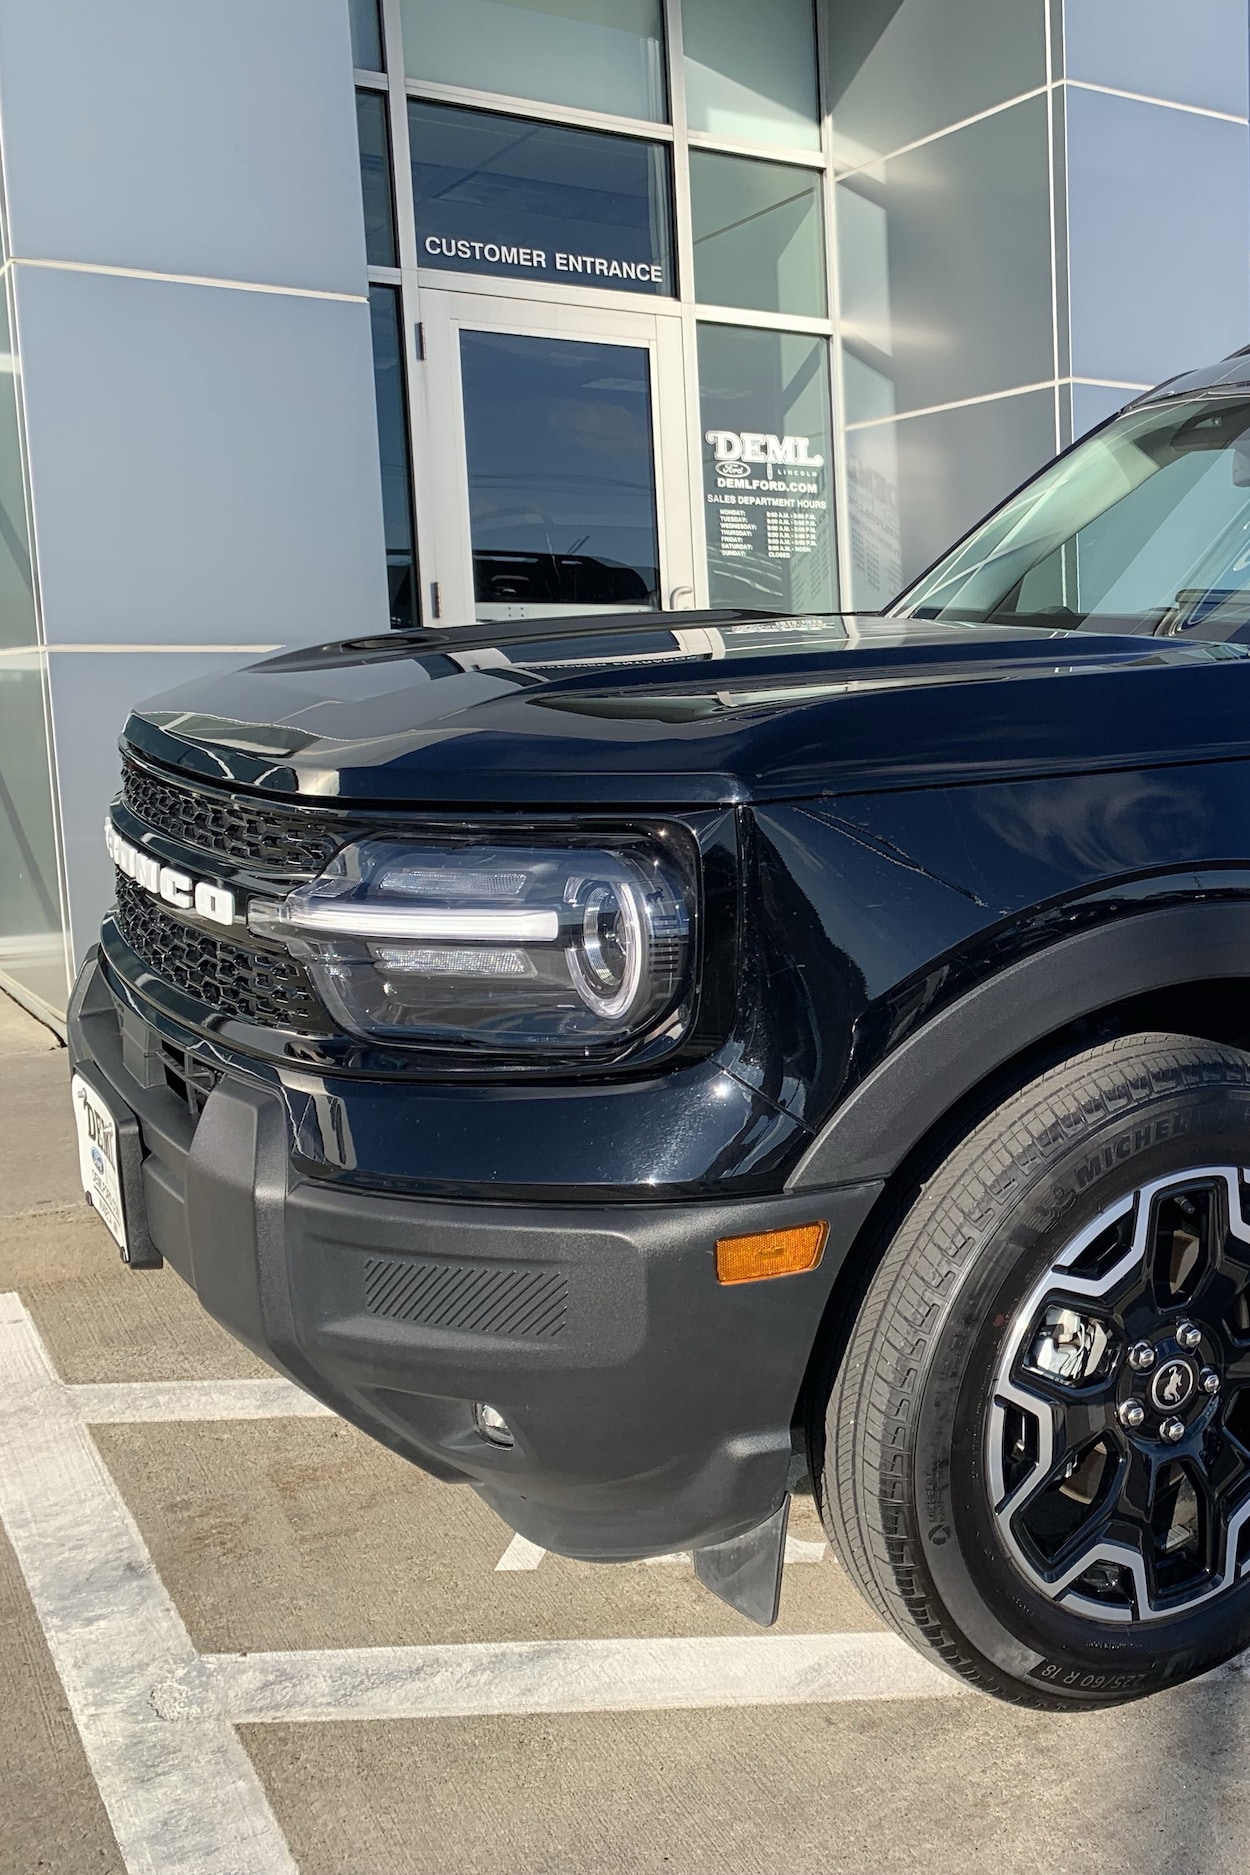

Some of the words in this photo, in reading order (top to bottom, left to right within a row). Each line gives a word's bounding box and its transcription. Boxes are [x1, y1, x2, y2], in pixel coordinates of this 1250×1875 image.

[425, 236, 546, 268] CUSTOMER
[554, 252, 663, 283] ENTRANCE
[705, 430, 824, 467] DEML
[777, 469, 817, 477] LINCOLN
[717, 478, 818, 493] DEMLFORD.COM
[707, 494, 736, 504] SALES
[738, 495, 795, 507] DEPARTMENT
[797, 499, 827, 509] HOURS
[1076, 1105, 1212, 1188] MICHEL
[1041, 1664, 1062, 1679] 18
[1063, 1670, 1081, 1685] R
